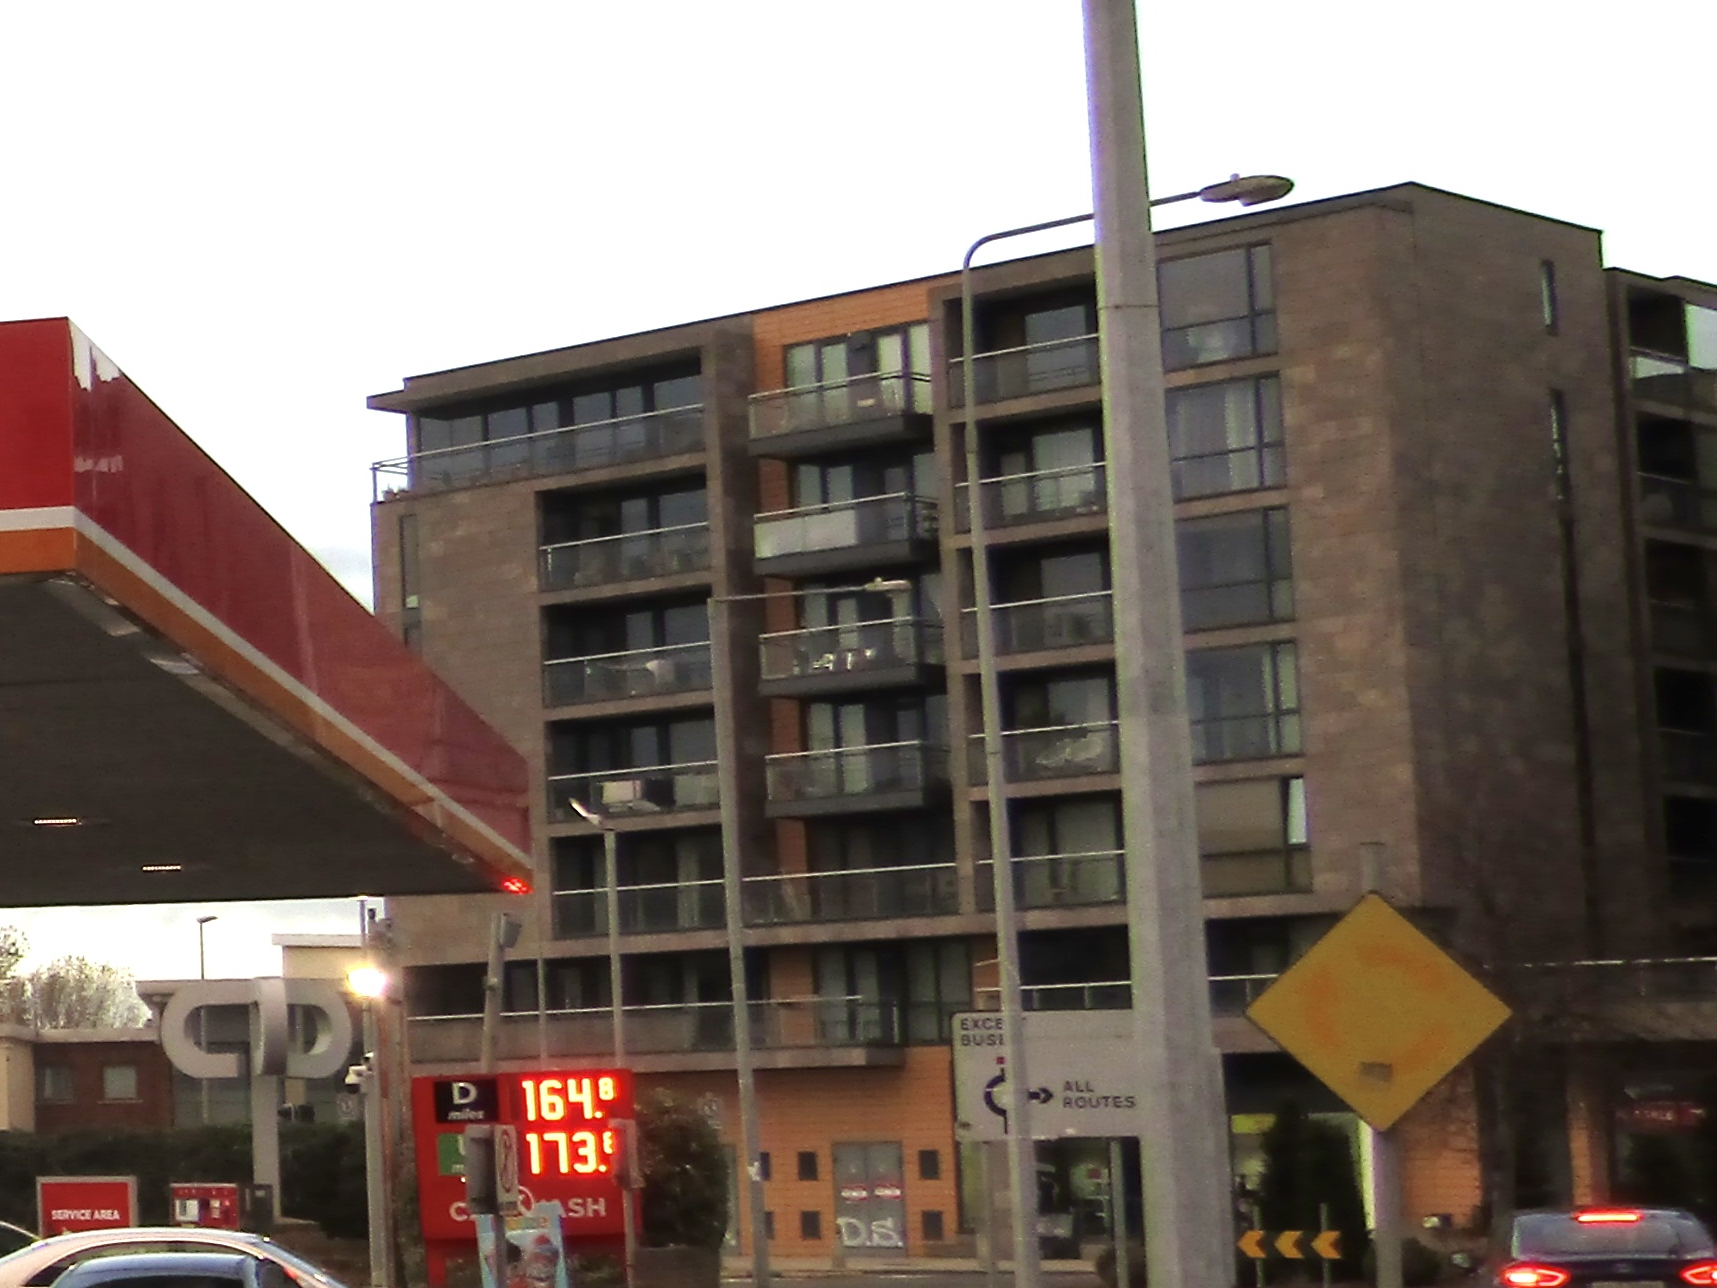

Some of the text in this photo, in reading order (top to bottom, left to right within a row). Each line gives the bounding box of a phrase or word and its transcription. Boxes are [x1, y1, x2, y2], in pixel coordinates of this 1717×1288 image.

[960, 1017, 1005, 1031] EXCE
[451, 1081, 477, 1105] D
[1063, 1080, 1095, 1093] ALL
[1062, 1095, 1137, 1109] ROUTES
[51, 1209, 120, 1221] SERVICE AREA
